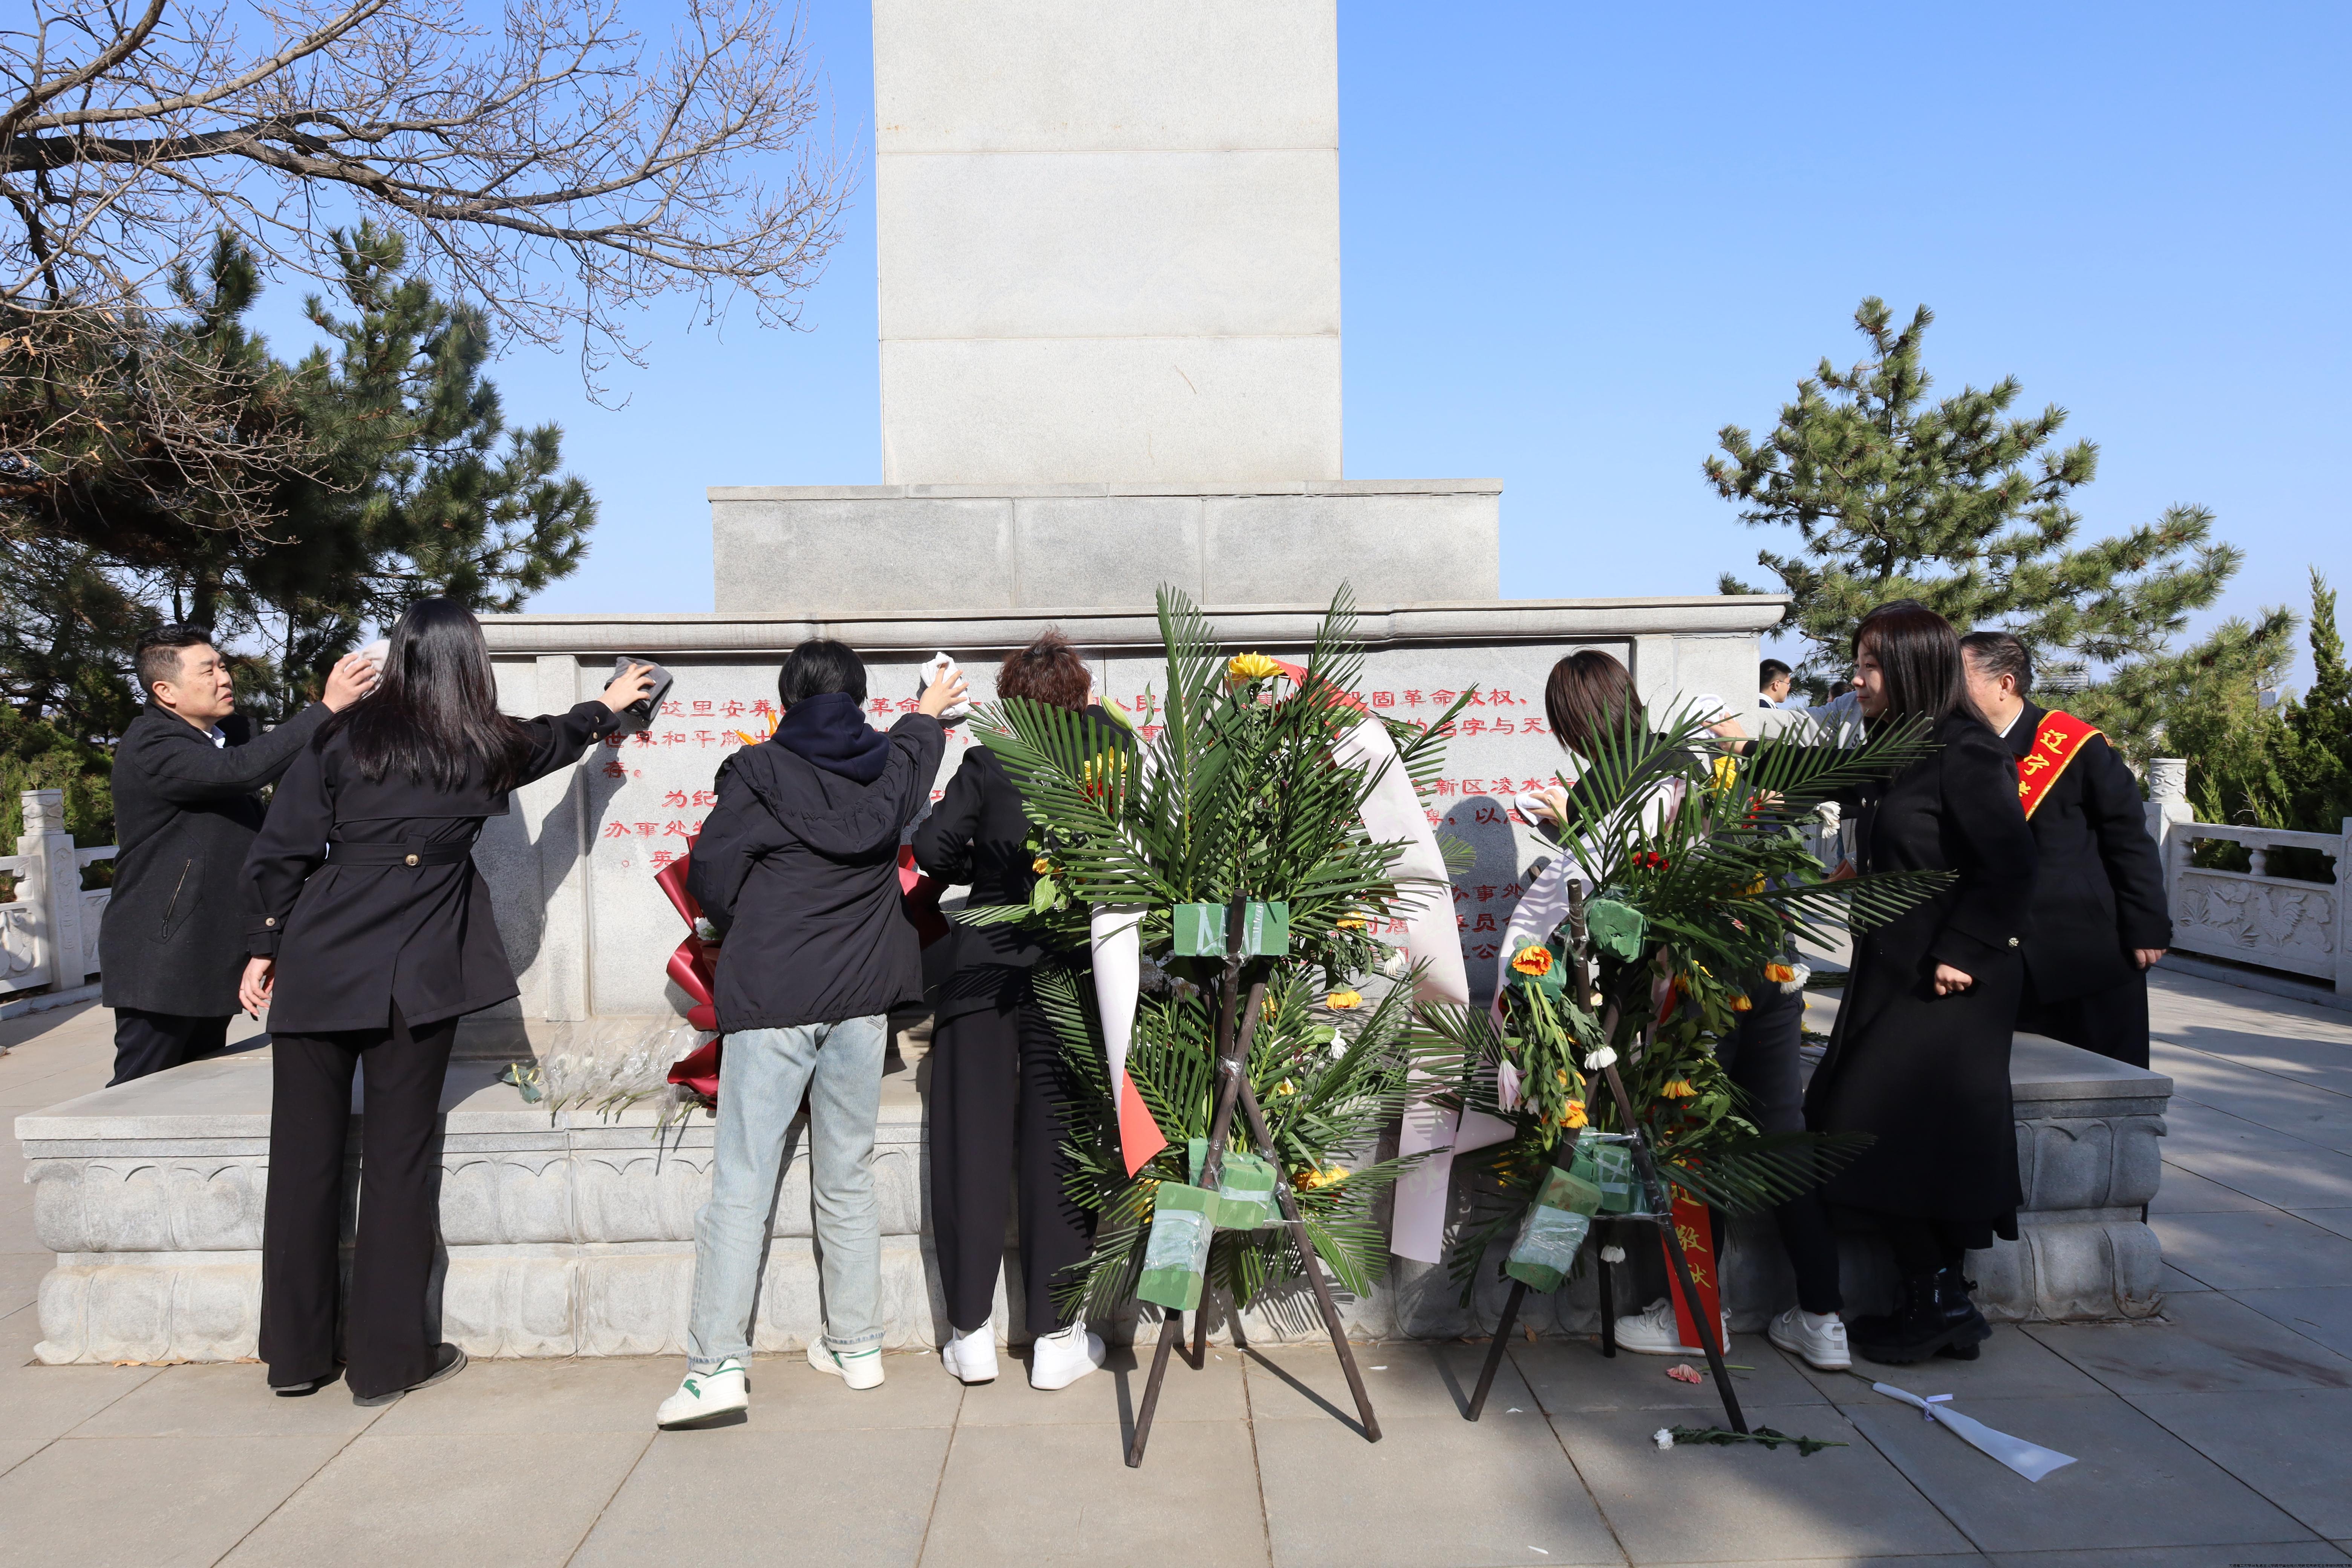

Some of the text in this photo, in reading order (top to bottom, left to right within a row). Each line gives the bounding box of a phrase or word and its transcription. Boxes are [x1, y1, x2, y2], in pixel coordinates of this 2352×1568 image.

[1407, 717, 1554, 737] 的名字与天
[603, 760, 642, 779] 存。
[662, 790, 717, 808] 为纪
